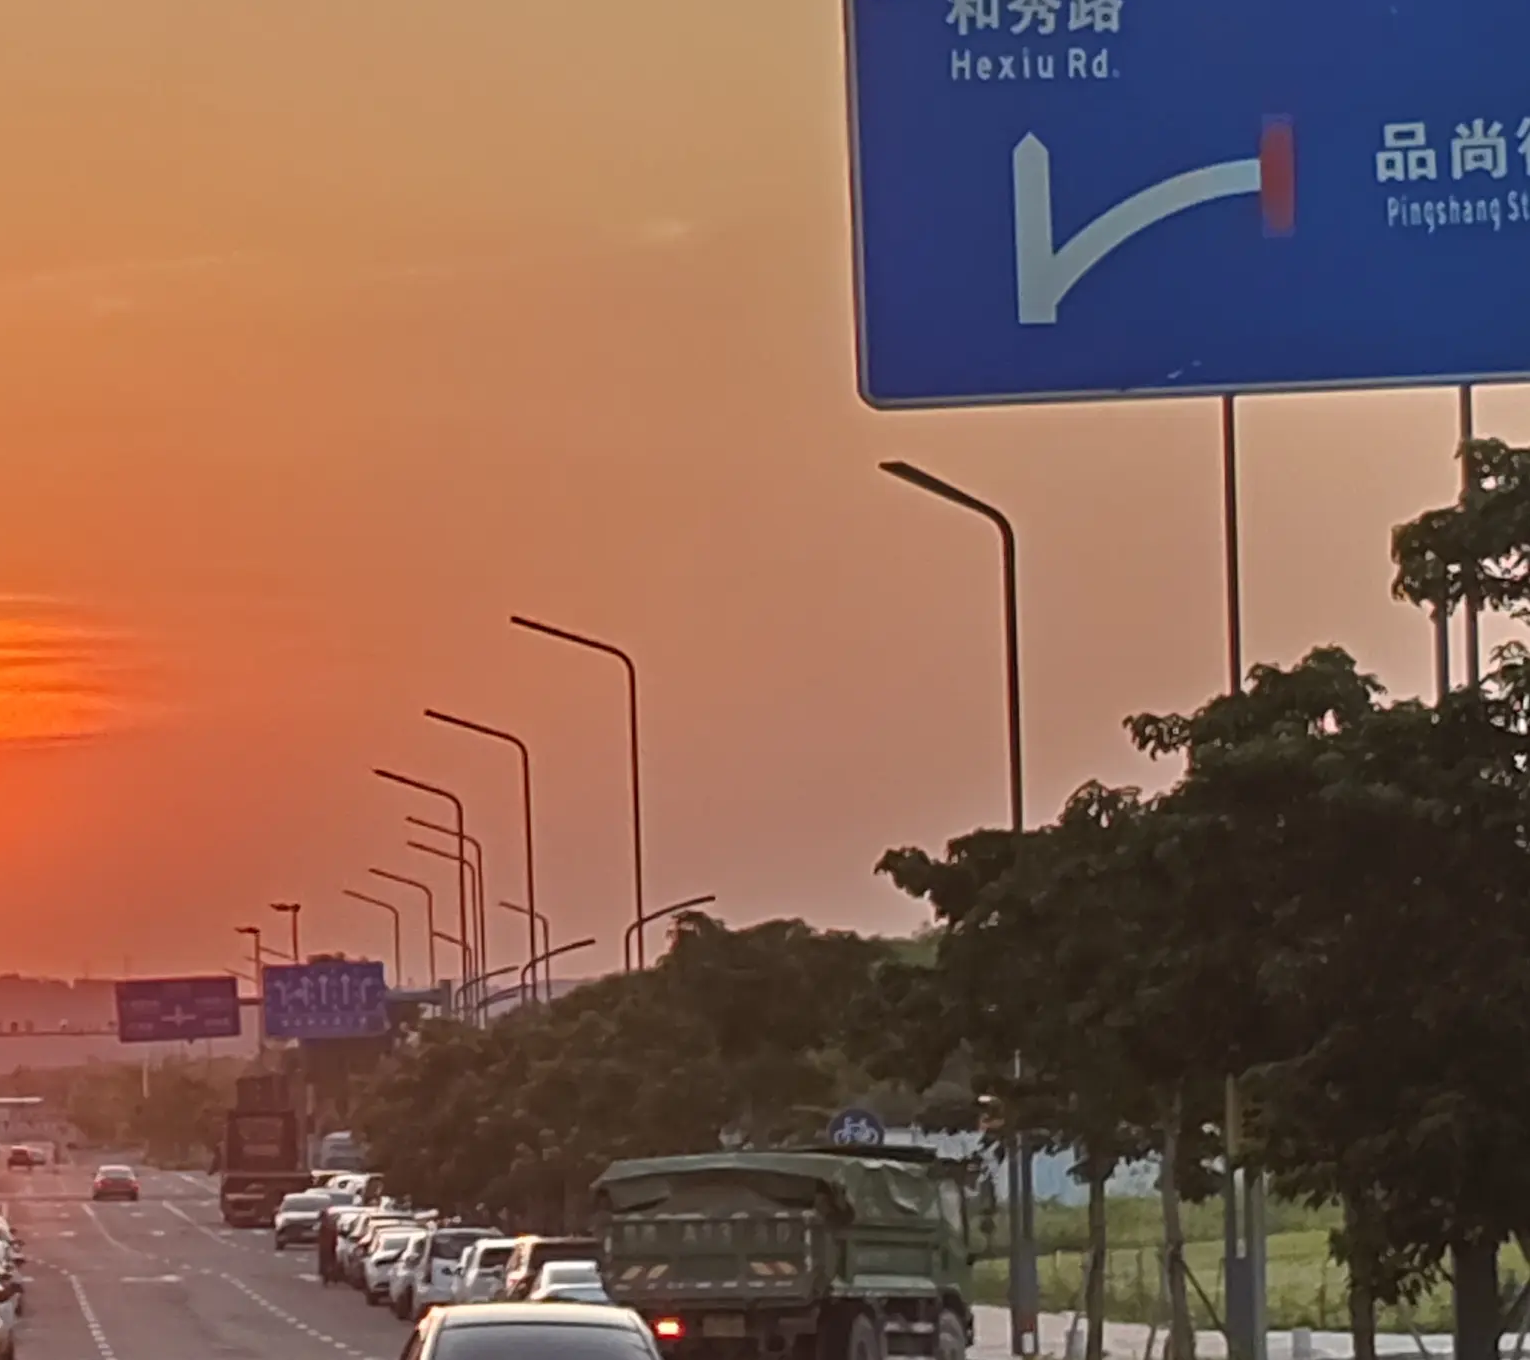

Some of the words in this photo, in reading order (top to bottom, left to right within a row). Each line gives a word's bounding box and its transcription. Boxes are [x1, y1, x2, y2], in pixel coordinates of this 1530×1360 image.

[951, 47, 1055, 80] Hexiu
[1068, 47, 1120, 79] Rd.
[1387, 194, 1501, 234] Pingshang
